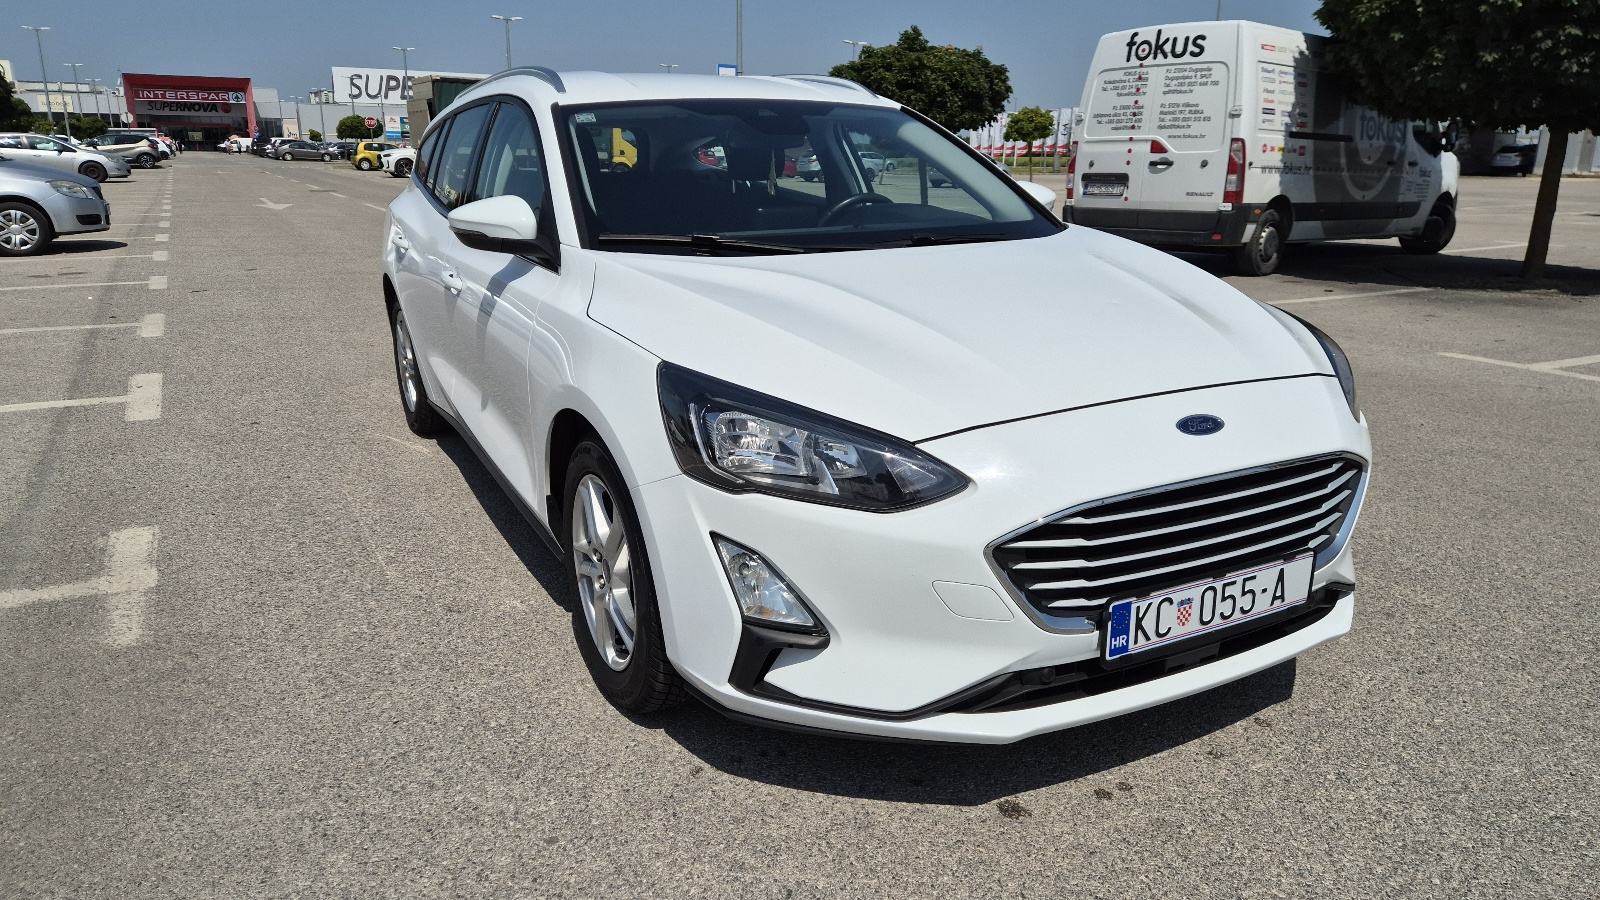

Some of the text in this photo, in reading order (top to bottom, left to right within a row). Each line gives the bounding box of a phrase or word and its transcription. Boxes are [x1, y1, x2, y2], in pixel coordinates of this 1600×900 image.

[1126, 29, 1207, 62] fokus
[140, 90, 229, 101] INTERSPAR
[147, 102, 218, 113] SUPERNOVA
[1187, 417, 1216, 432] Ford
[1110, 567, 1286, 650] HR KC 055-A
